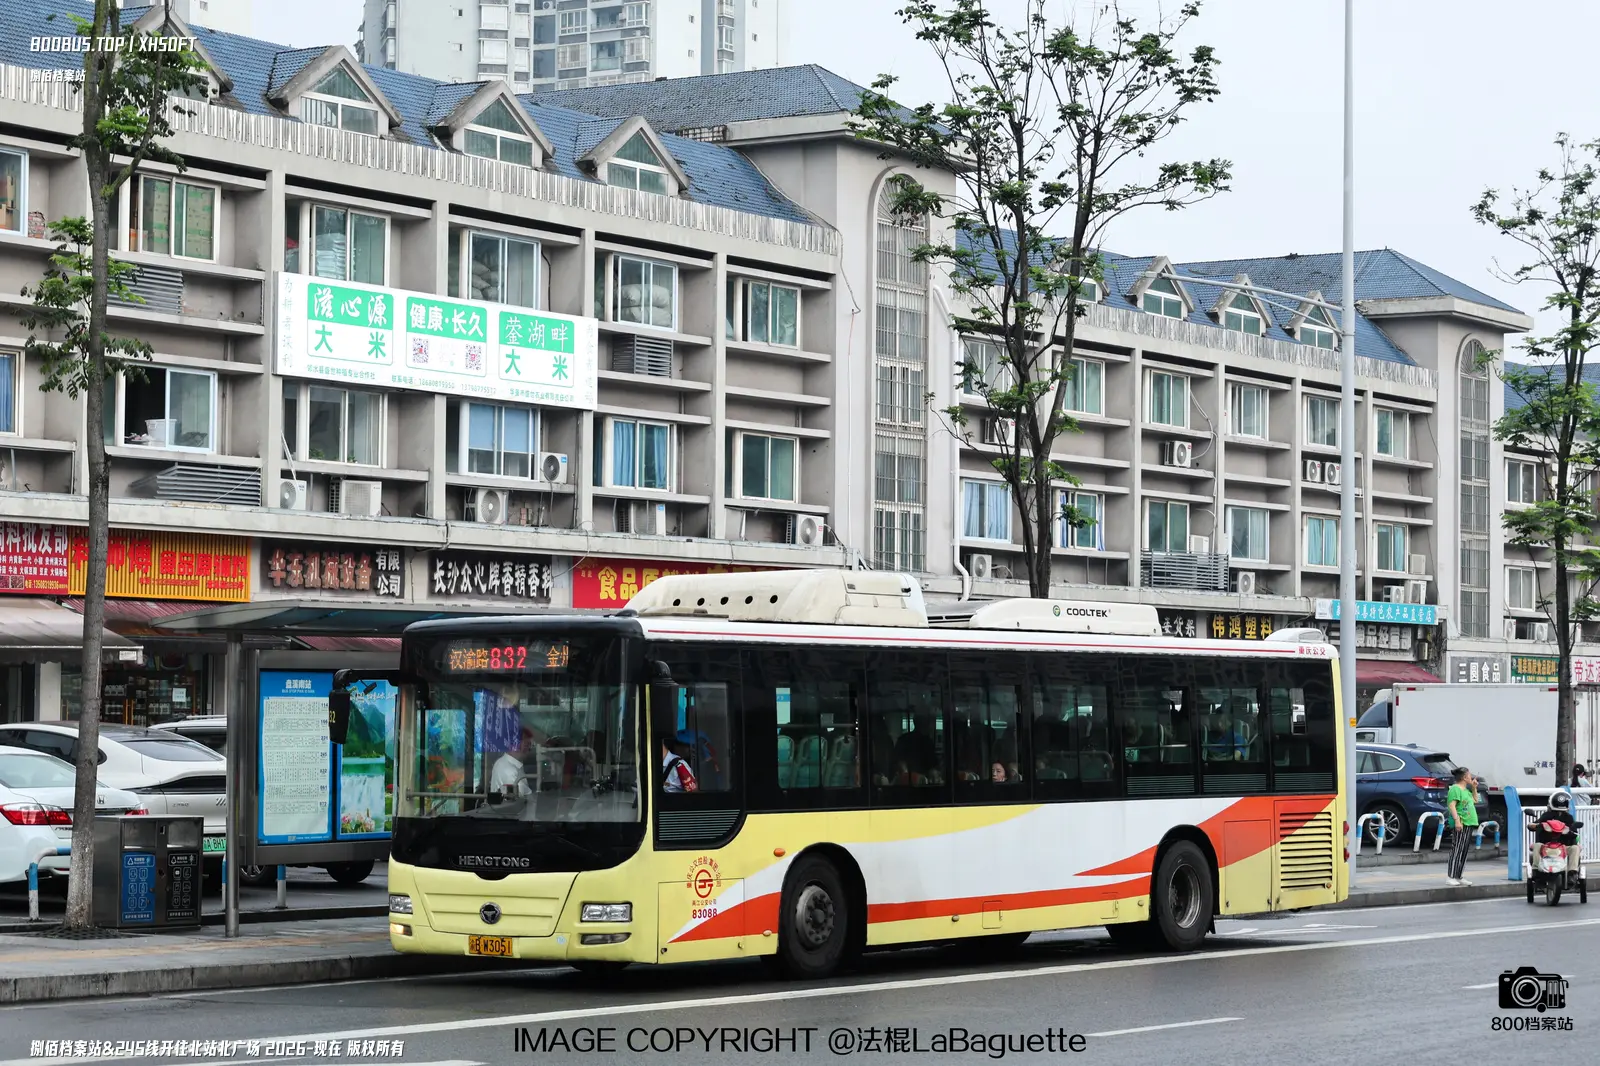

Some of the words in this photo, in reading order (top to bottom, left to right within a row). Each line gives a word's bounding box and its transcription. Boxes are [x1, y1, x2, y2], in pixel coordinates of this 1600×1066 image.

[313, 286, 388, 327] 滋心源
[314, 324, 387, 359] 大米
[505, 316, 569, 352] 蓥湖畔
[505, 349, 568, 381] 大米
[376, 549, 400, 571] 有限
[377, 574, 401, 597] 公司
[1066, 607, 1108, 619] COOLTEK
[1212, 613, 1273, 640] 伟鸿塑料
[490, 645, 528, 670] 832
[1298, 645, 1326, 656] 重庆公交
[458, 855, 530, 868] HENGTONG
[691, 907, 718, 920] 83088
